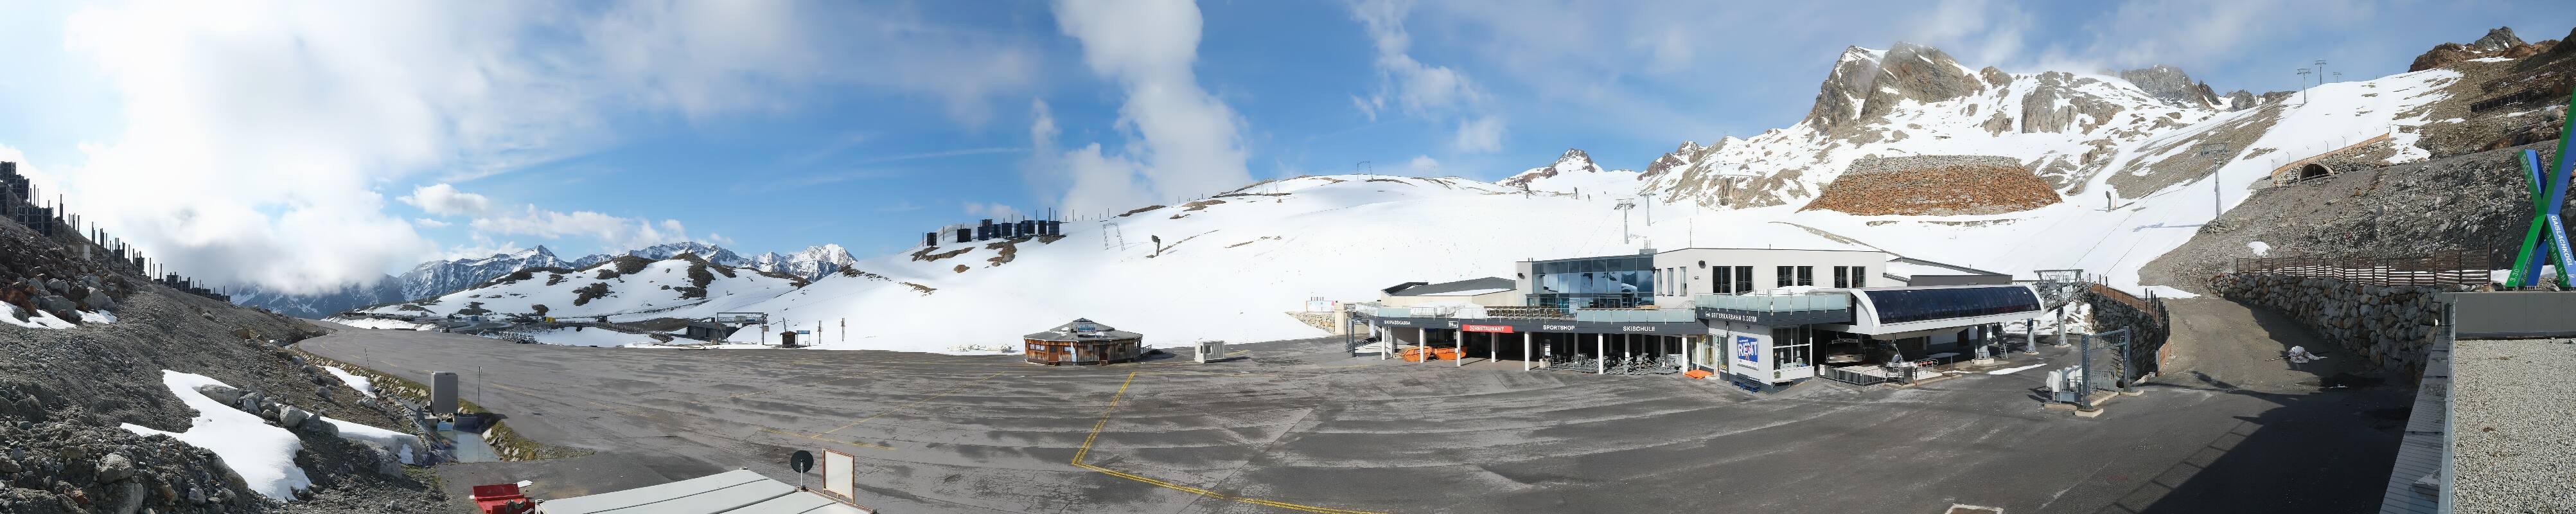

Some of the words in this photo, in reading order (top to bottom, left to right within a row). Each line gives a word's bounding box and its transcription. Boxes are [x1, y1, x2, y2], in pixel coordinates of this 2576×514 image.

[2521, 154, 2530, 175] BIG
[2528, 175, 2533, 184] 3
[2551, 215, 2573, 266] GAISLACHKOGL
[1711, 312, 1742, 321] SEITERKARBAHN
[1738, 341, 1758, 356] RENT
